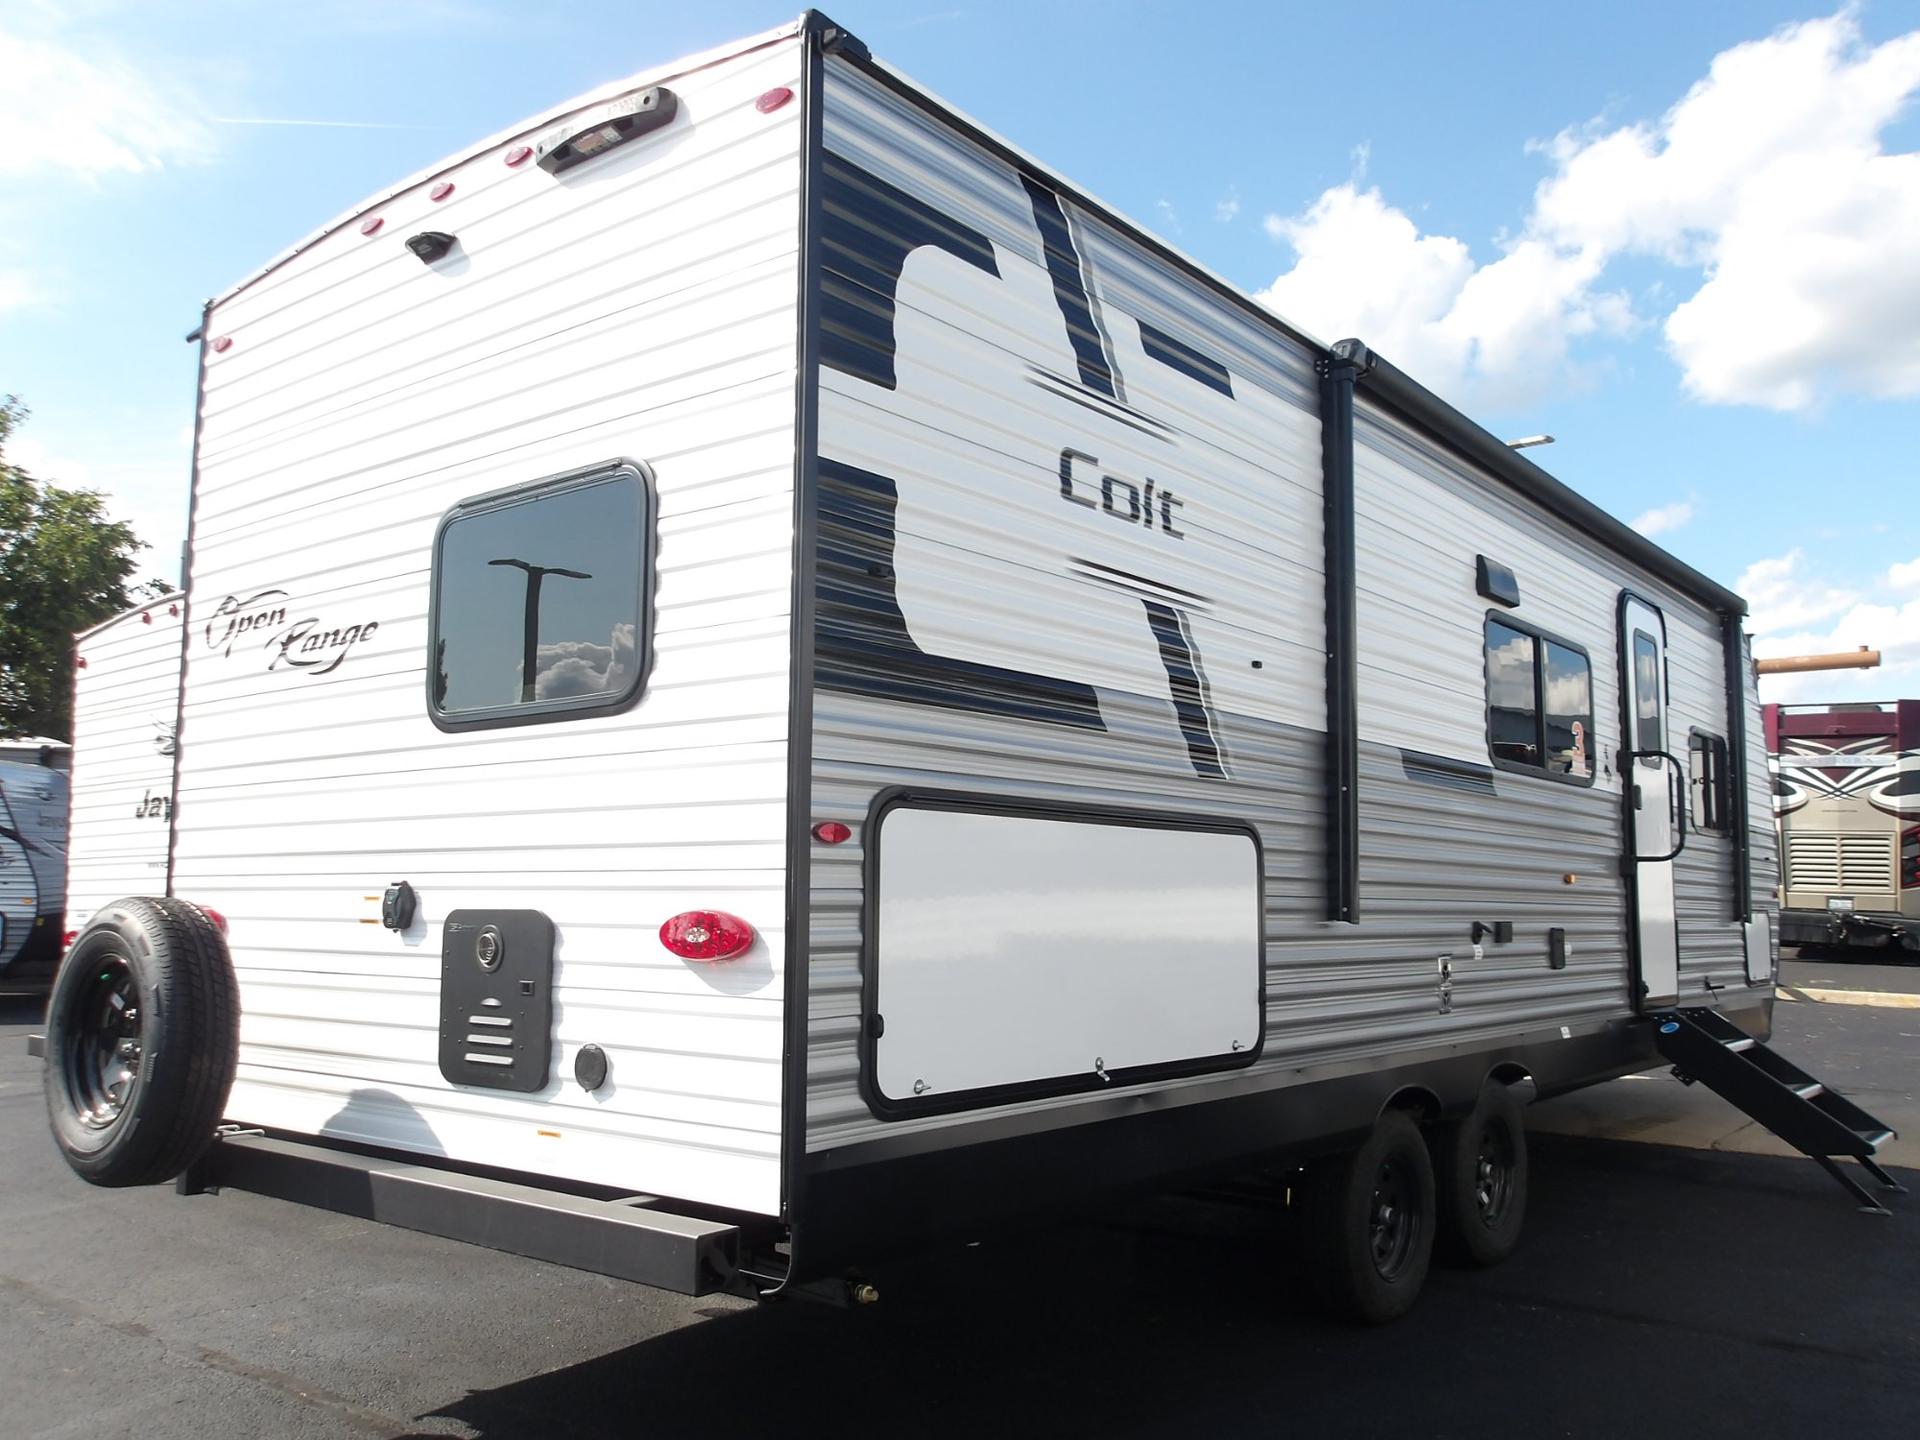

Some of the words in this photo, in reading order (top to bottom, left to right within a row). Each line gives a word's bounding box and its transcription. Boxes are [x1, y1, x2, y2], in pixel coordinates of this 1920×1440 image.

[1059, 446, 1185, 540] Colt
[205, 589, 289, 658] Open
[264, 617, 379, 675] Range
